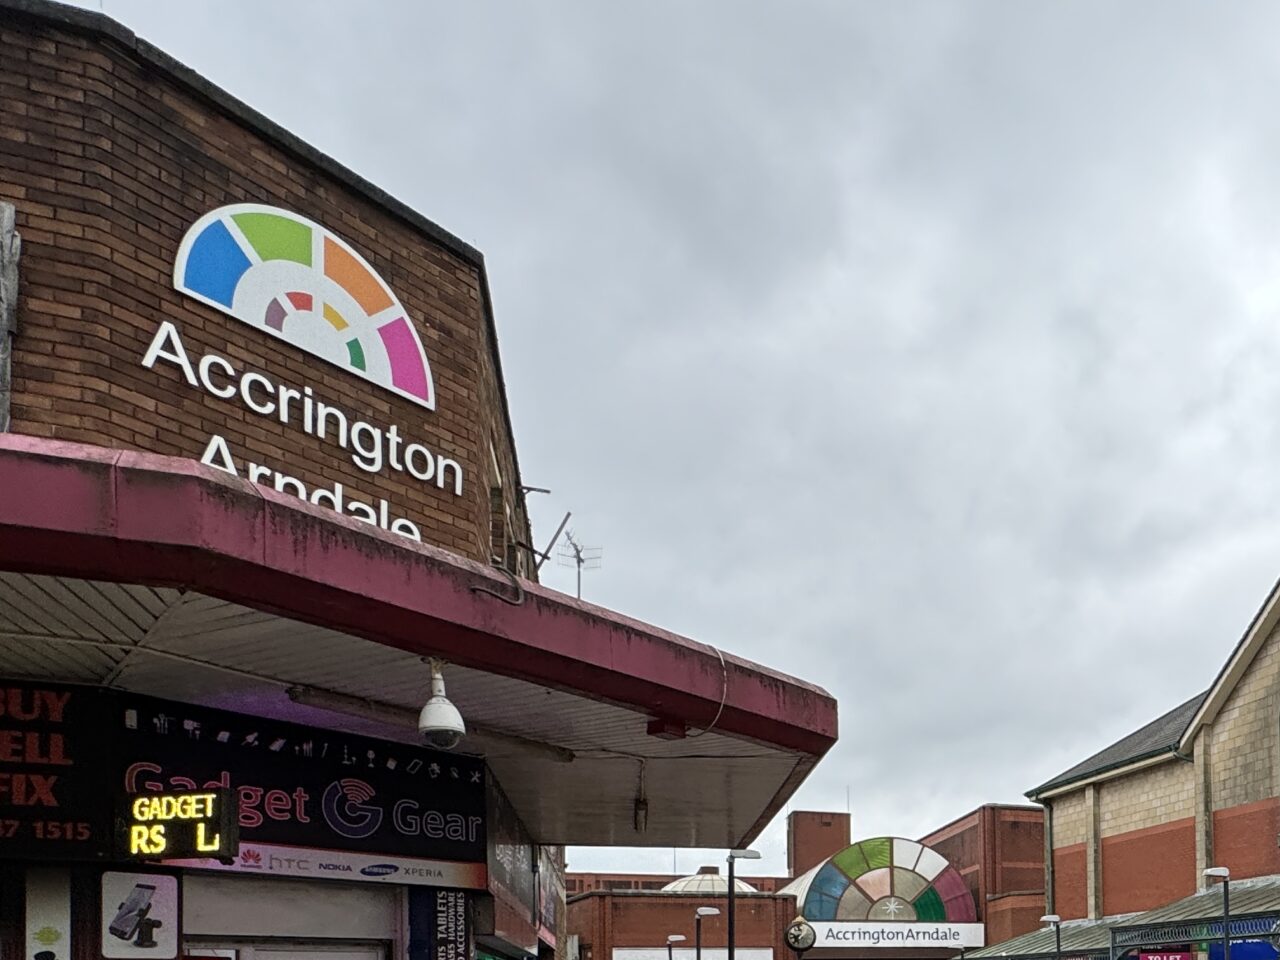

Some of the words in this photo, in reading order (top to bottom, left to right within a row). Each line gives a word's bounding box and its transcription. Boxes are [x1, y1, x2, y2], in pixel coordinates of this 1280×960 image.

[141, 320, 463, 497] Accrington
[0, 688, 71, 722] UY
[0, 730, 73, 765] ELL
[132, 794, 217, 821] GADGET
[393, 800, 482, 842] Gear
[33, 821, 91, 840] 1515
[130, 825, 166, 854] RS
[318, 863, 353, 872] NOKIA
[403, 867, 444, 878] XPERIA
[437, 891, 447, 939] TABLETS
[447, 891, 455, 940] HARDWARE
[456, 891, 465, 954] ACCESSORIES
